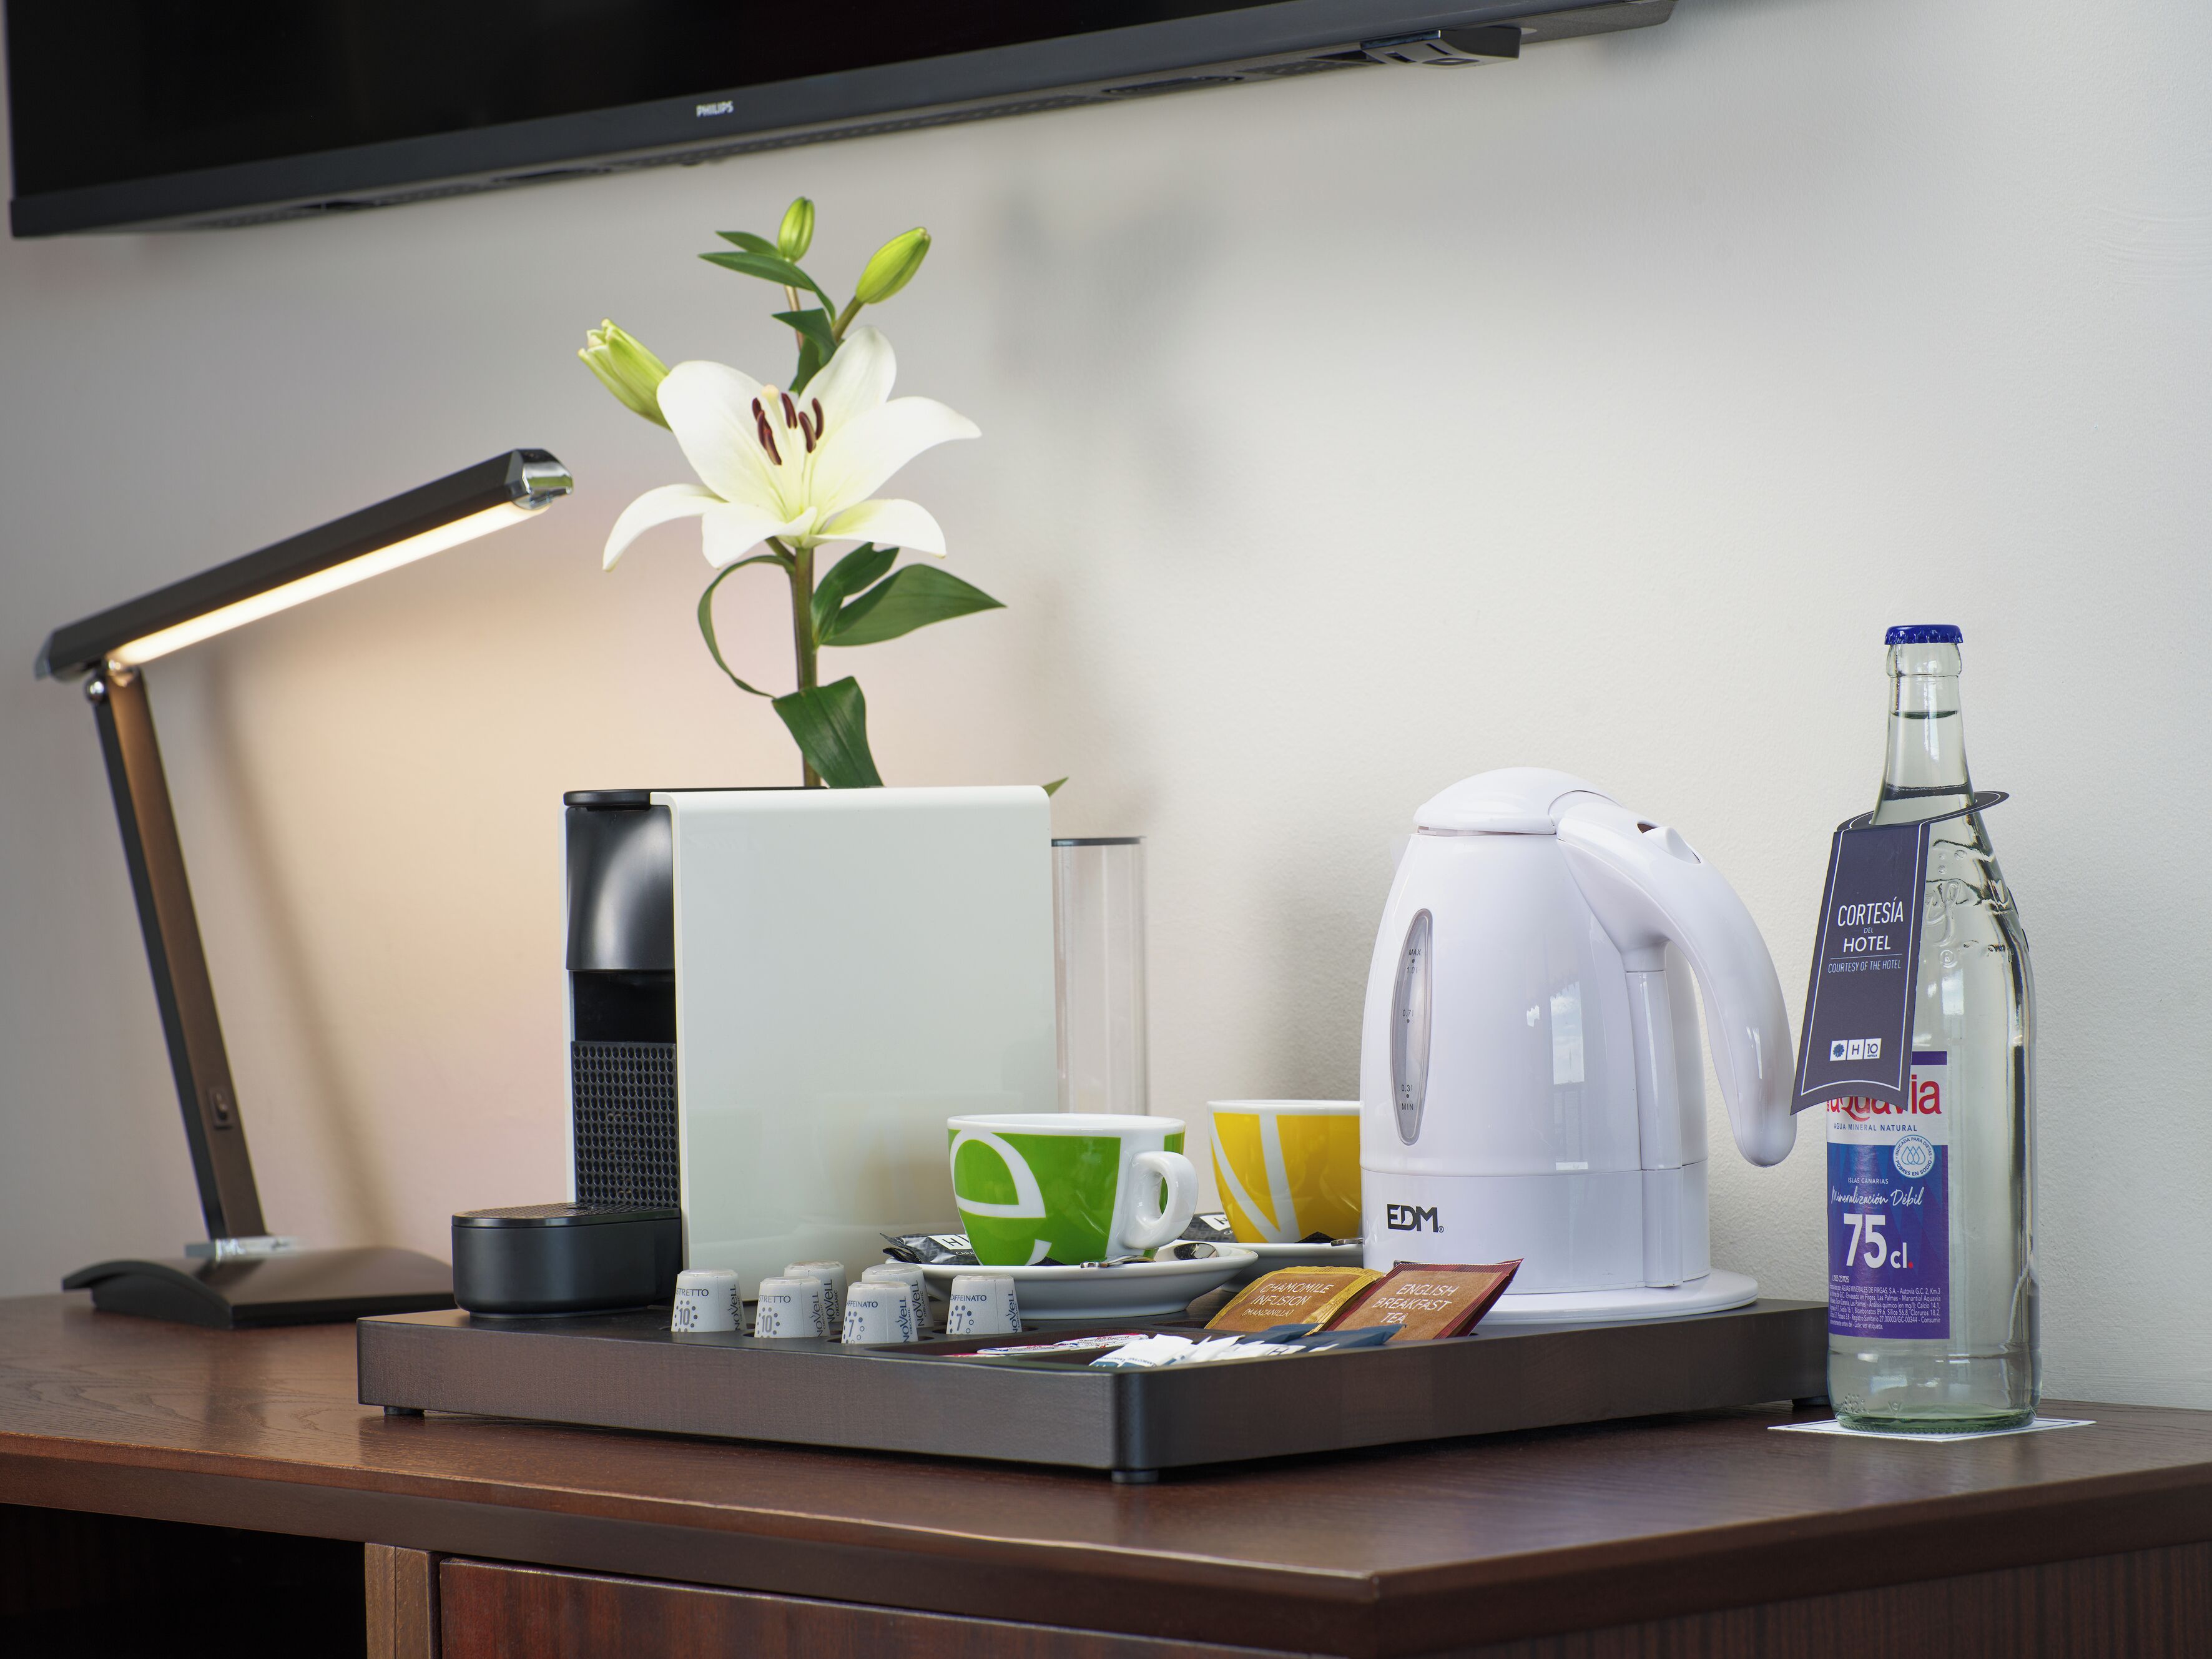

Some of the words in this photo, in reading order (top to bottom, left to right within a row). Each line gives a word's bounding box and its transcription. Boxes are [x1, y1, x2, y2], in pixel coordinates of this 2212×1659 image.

[696, 101, 734, 117] PHILIPS
[1837, 896, 1904, 927] CORTESÍA
[1843, 935, 1891, 953] HOTEL
[1828, 962, 1859, 973] COURTESY
[1861, 962, 1868, 972] OF
[1870, 960, 1881, 970] THE
[1882, 959, 1902, 970] HOTEL
[1848, 1123, 1877, 1131] MINERAL
[1895, 1137, 1910, 1156] INDICADA
[1923, 1141, 1933, 1156] DIETAS
[1895, 1160, 1911, 1176] POBRES
[1920, 1159, 1932, 1174] SODIO
[1831, 1186, 1888, 1205] Mineralización
[1890, 1186, 1925, 1207] Débil
[1844, 1213, 1887, 1269] 75
[1259, 1283, 1335, 1294] CHAMOMILE
[1396, 1284, 1460, 1296] ENGLISH
[1250, 1295, 1312, 1306] INFUSION
[1371, 1297, 1453, 1311] BREAKFAST
[679, 1307, 691, 1326] 10
[1241, 1308, 1294, 1317] (MANZANILLA)
[1380, 1312, 1407, 1324] TEA
[761, 1315, 773, 1333] 10
[848, 1319, 855, 1337] 7
[956, 1313, 963, 1331] 7
